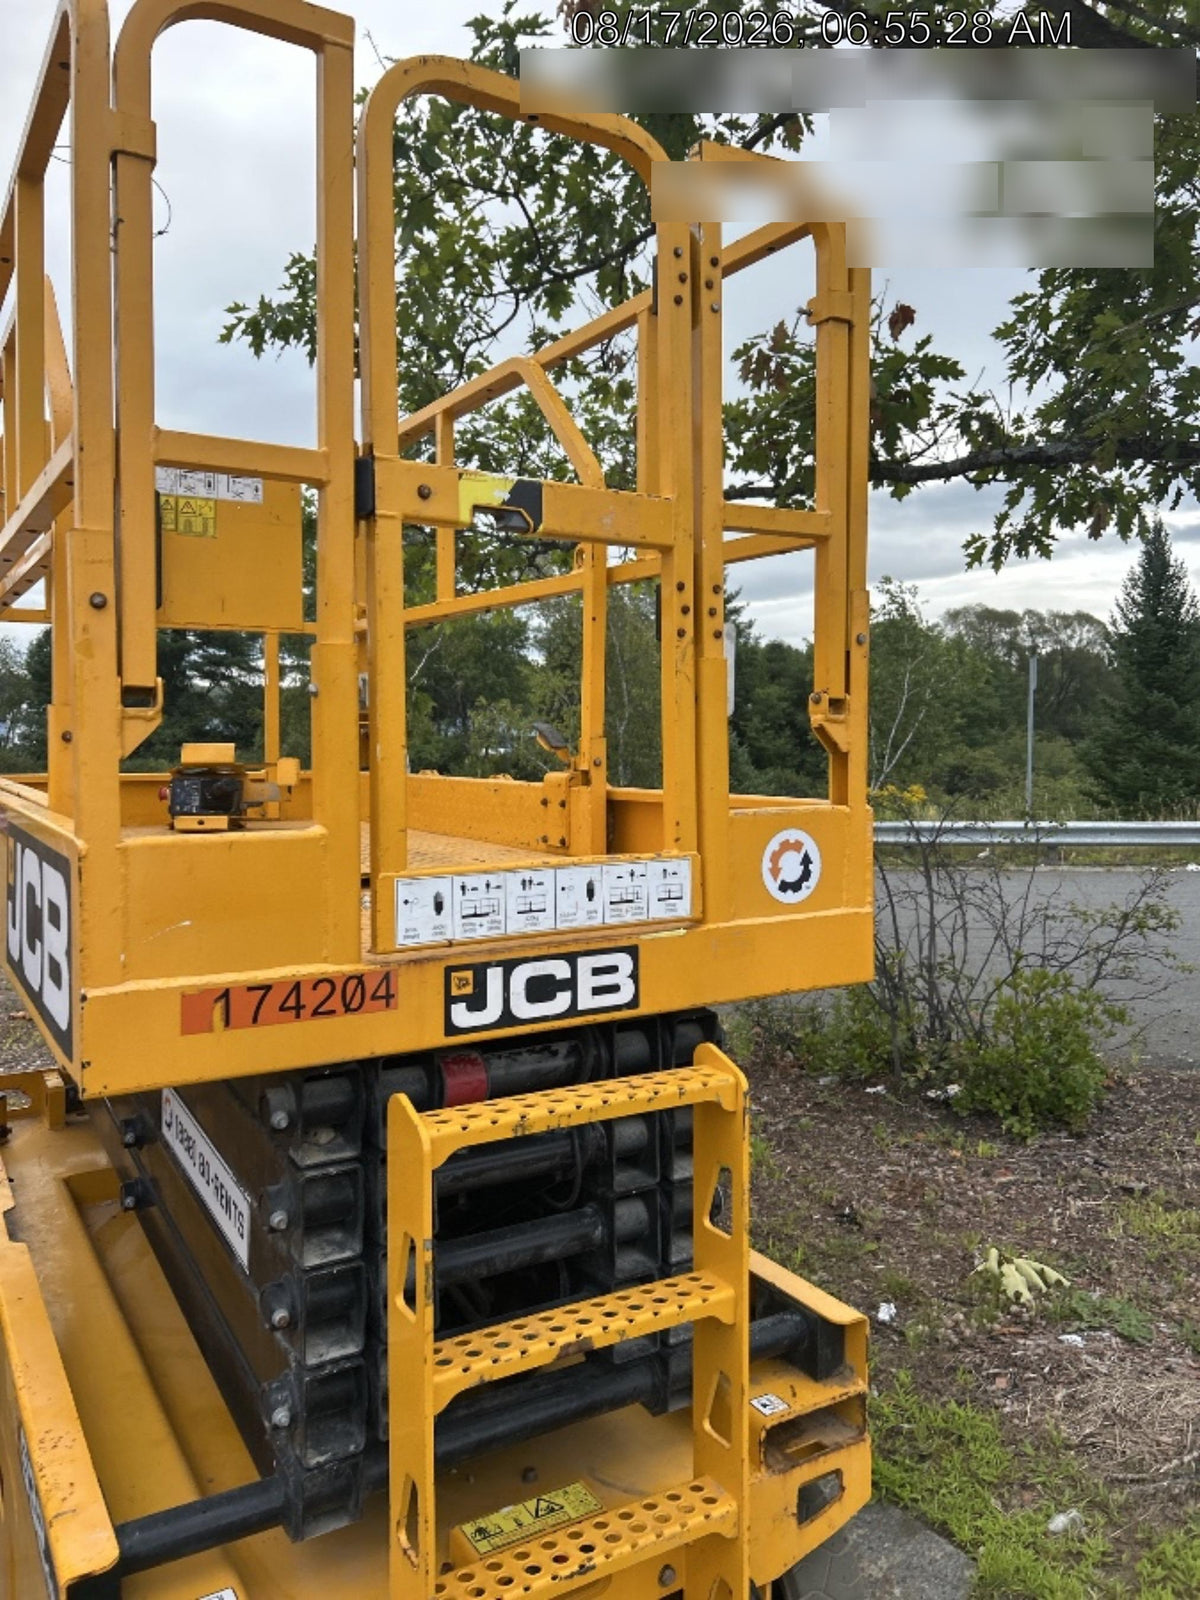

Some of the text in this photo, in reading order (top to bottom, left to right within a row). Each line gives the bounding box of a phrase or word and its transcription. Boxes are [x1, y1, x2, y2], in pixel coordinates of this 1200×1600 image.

[8, 841, 70, 1032] JCB
[214, 970, 395, 1028] 174204
[451, 953, 635, 1028] JCB
